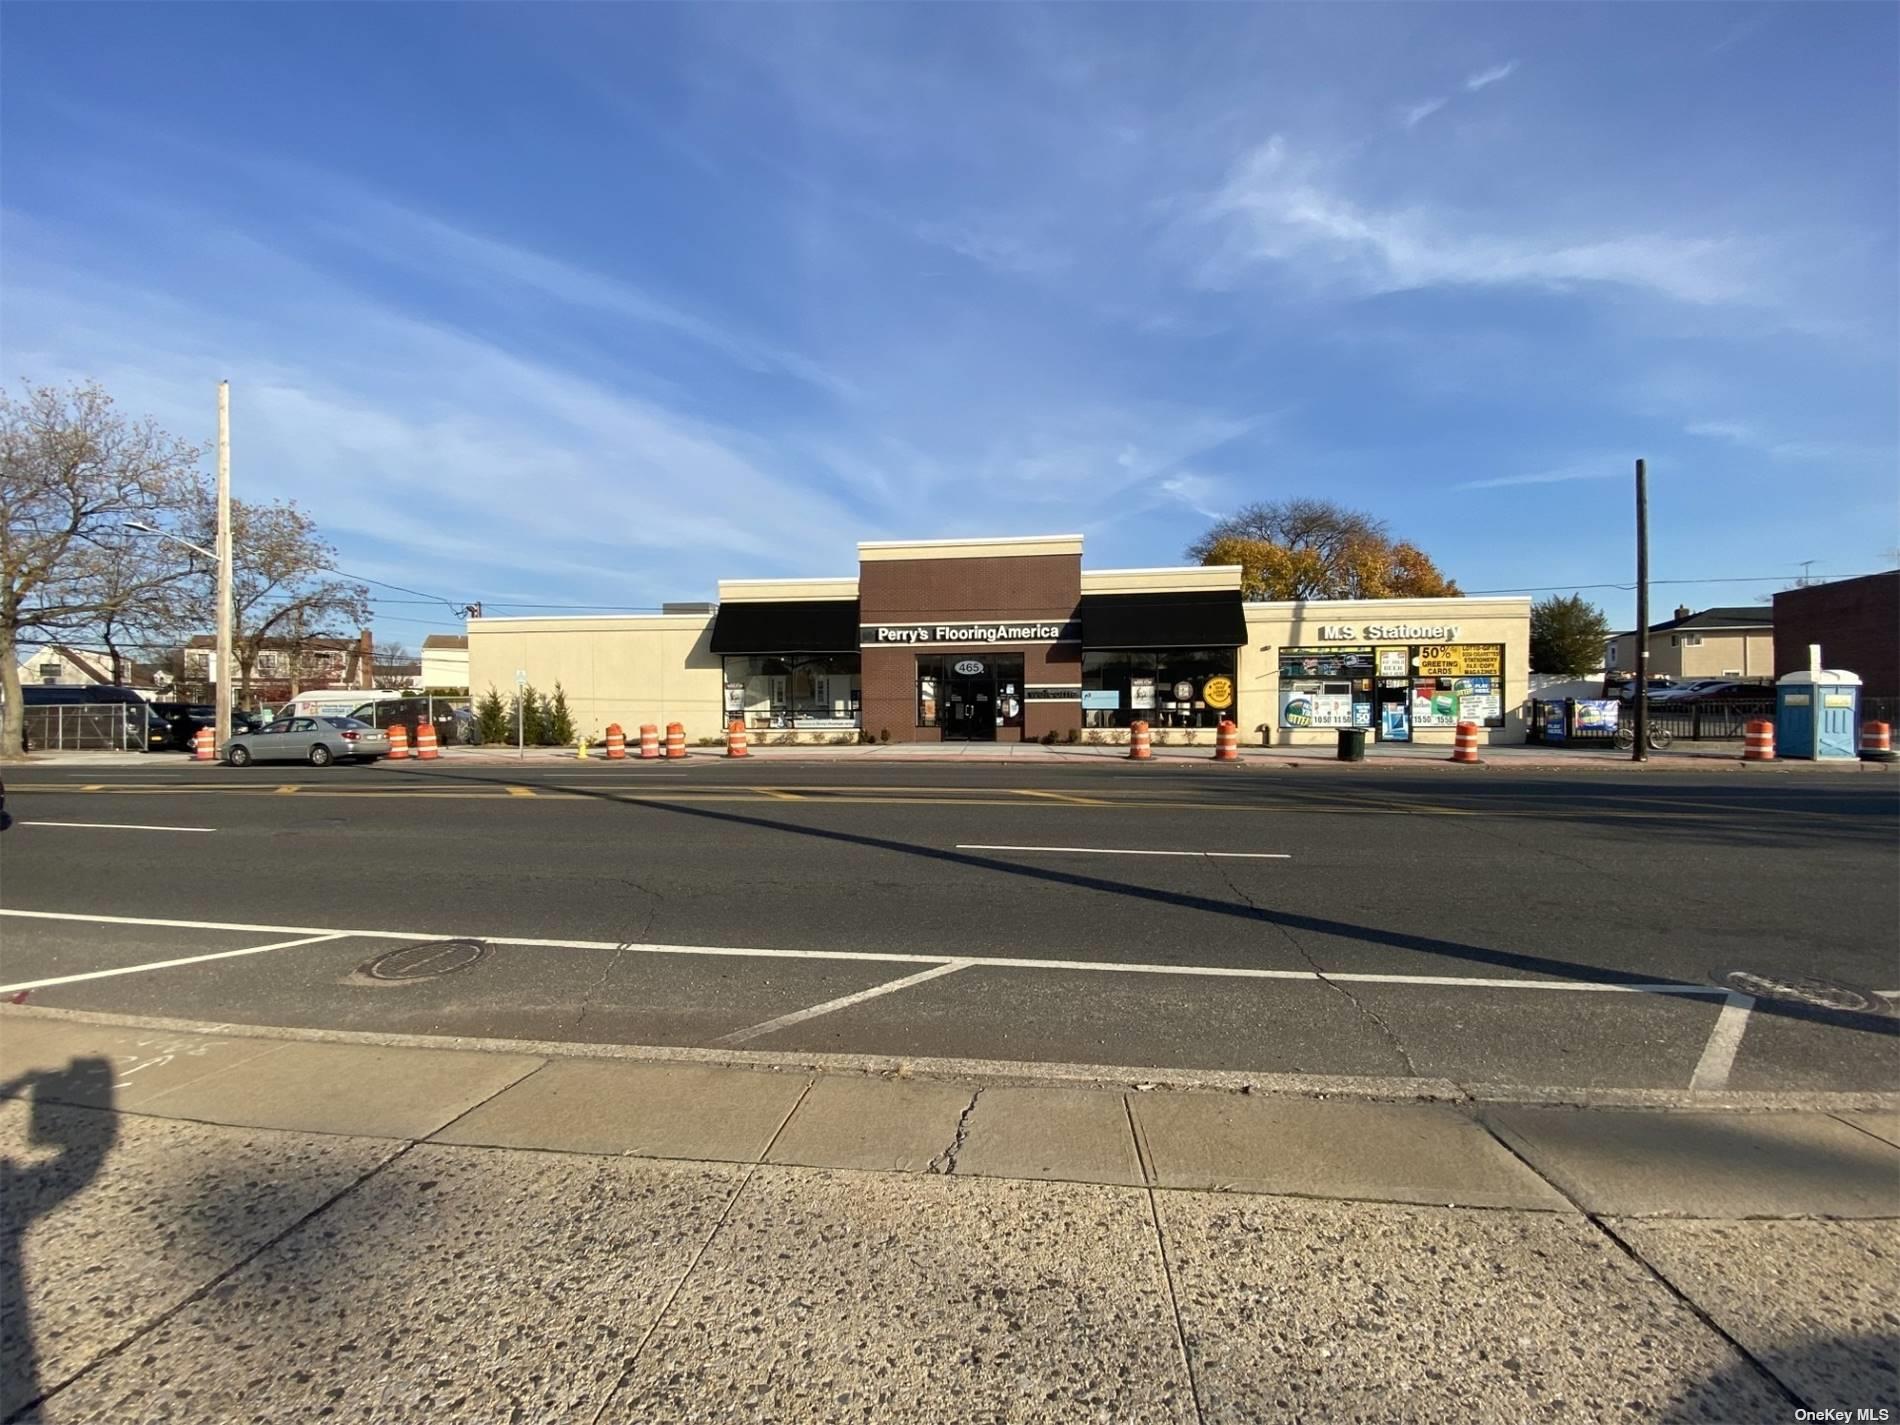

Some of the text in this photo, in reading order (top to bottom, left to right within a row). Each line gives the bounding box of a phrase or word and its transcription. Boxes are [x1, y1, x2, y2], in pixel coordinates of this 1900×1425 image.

[878, 628, 928, 643] Perry's
[1369, 624, 1461, 641] Stationery
[1422, 646, 1451, 658] 50%
[959, 663, 980, 672] 465
